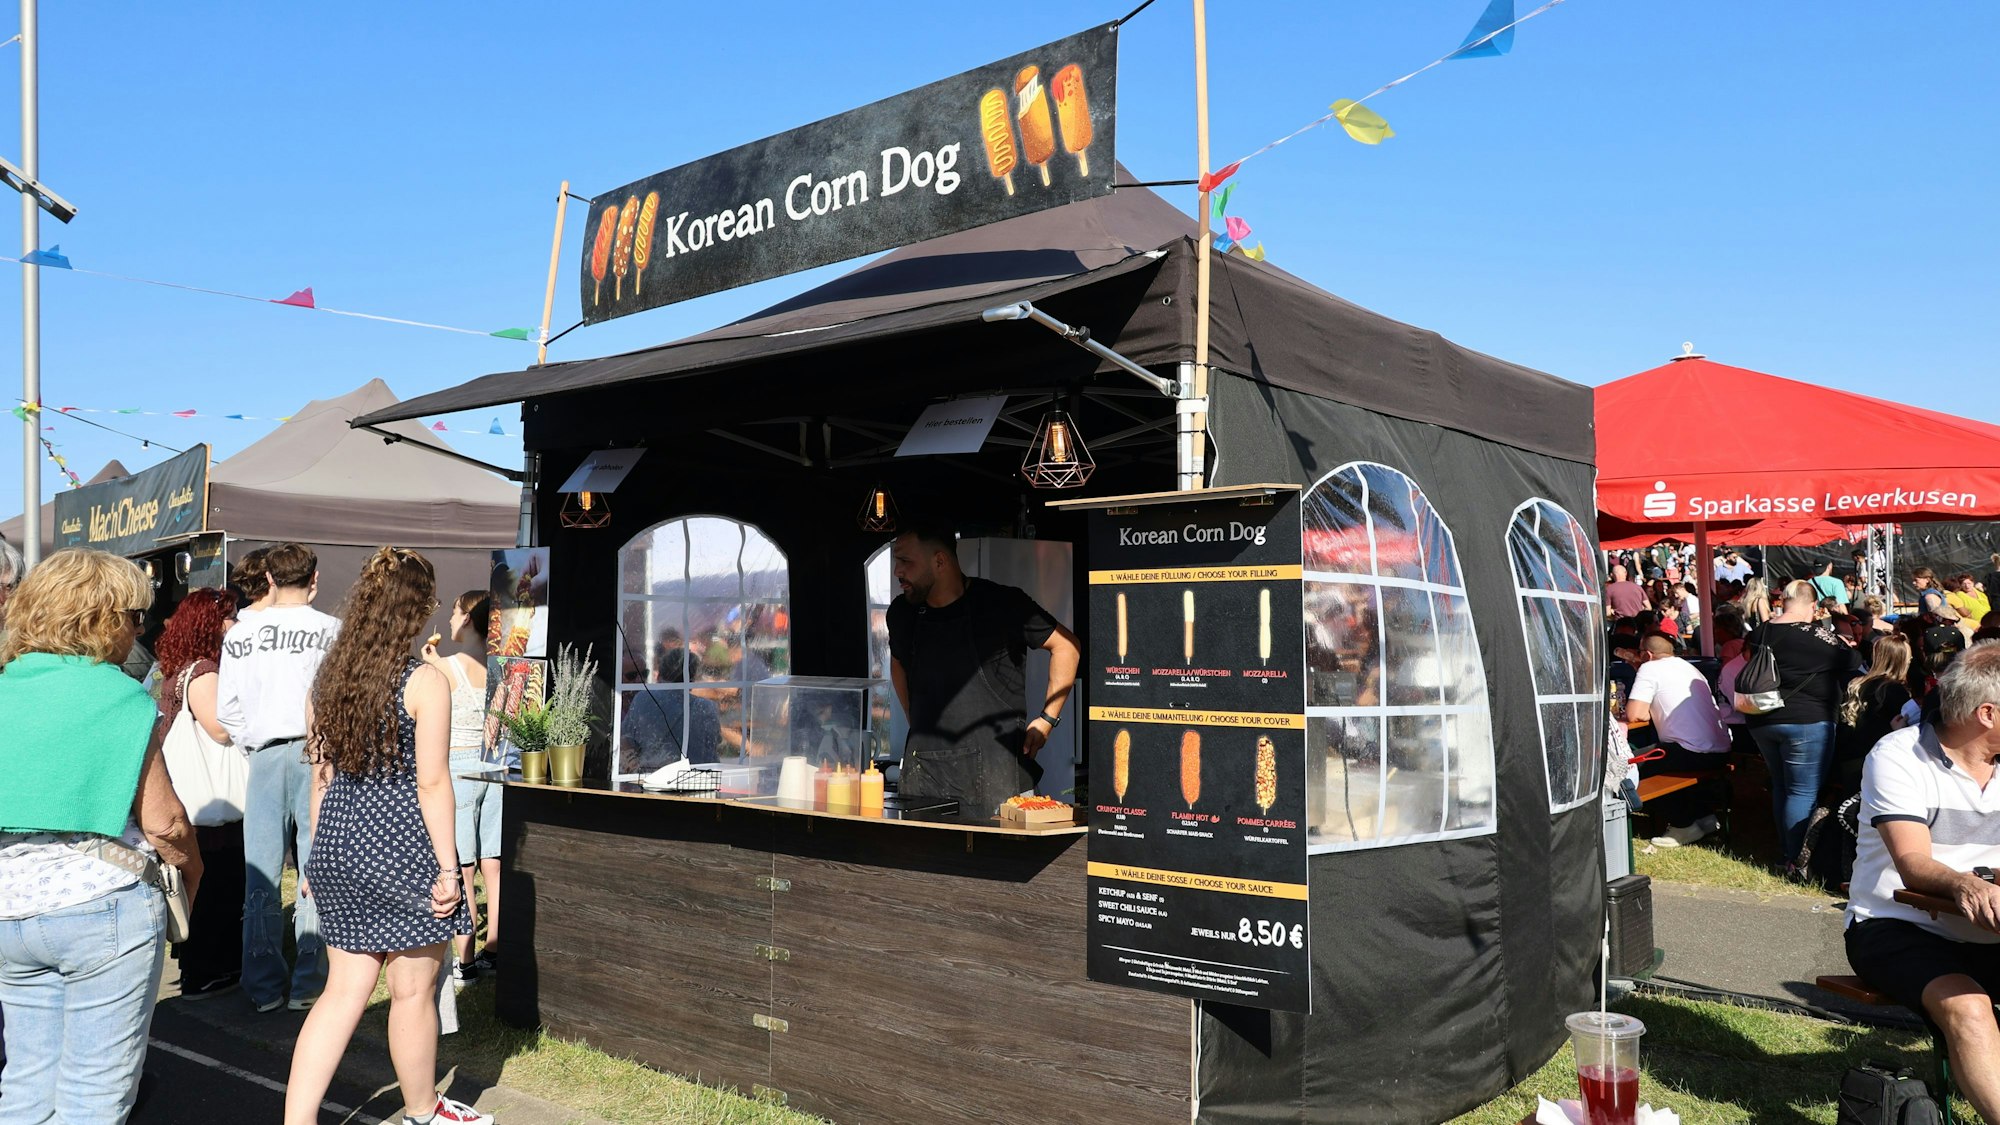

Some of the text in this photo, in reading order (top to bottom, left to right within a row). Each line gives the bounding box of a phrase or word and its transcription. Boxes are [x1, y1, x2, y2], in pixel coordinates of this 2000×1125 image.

[666, 142, 960, 258] Korean Corn Dog
[925, 417, 983, 428] Hier bestellen
[1689, 494, 1815, 519] Sparkasse
[1824, 487, 1977, 512] Leverkusen
[1119, 521, 1266, 546] Korean Corn Dog
[1116, 573, 1139, 581] WÄHLE
[1161, 571, 1191, 580] FÜLLUNG
[1197, 571, 1226, 579] CHOOSE
[1227, 570, 1248, 578] YOUR
[1250, 569, 1277, 578] FILLING
[1106, 666, 1140, 675] WÜRSTCHEN
[1242, 670, 1287, 678] MOZZARELLA
[1107, 710, 1131, 719] WÄHLE
[1152, 713, 1203, 723] UMMANTELUNG
[1210, 715, 1239, 723] CHOOSE
[1241, 716, 1262, 724] YOUR
[1263, 717, 1291, 726] COVER
[1096, 805, 1147, 816] CRUNCHY CLASSIC
[1196, 814, 1209, 822] HOT
[1237, 817, 1264, 826] POMMES
[1121, 869, 1145, 880] WÄHLE
[1146, 872, 1166, 882] DEINE
[1166, 874, 1188, 885] SOSSE
[1194, 878, 1223, 888] CHOOSE
[1225, 881, 1246, 891] YOUR
[1248, 884, 1274, 894] SAUCE
[1098, 886, 1126, 898] KETCHUP
[1136, 892, 1142, 900] &
[1142, 893, 1158, 902] SENF
[1098, 900, 1119, 911] SWEET
[1119, 902, 1136, 913] CHILI
[1136, 905, 1157, 916] SAUCE
[1098, 914, 1115, 924] SPICY
[1116, 916, 1135, 927] MAYO
[1190, 917, 1303, 950] JEWEILS NUR 8,50 €
